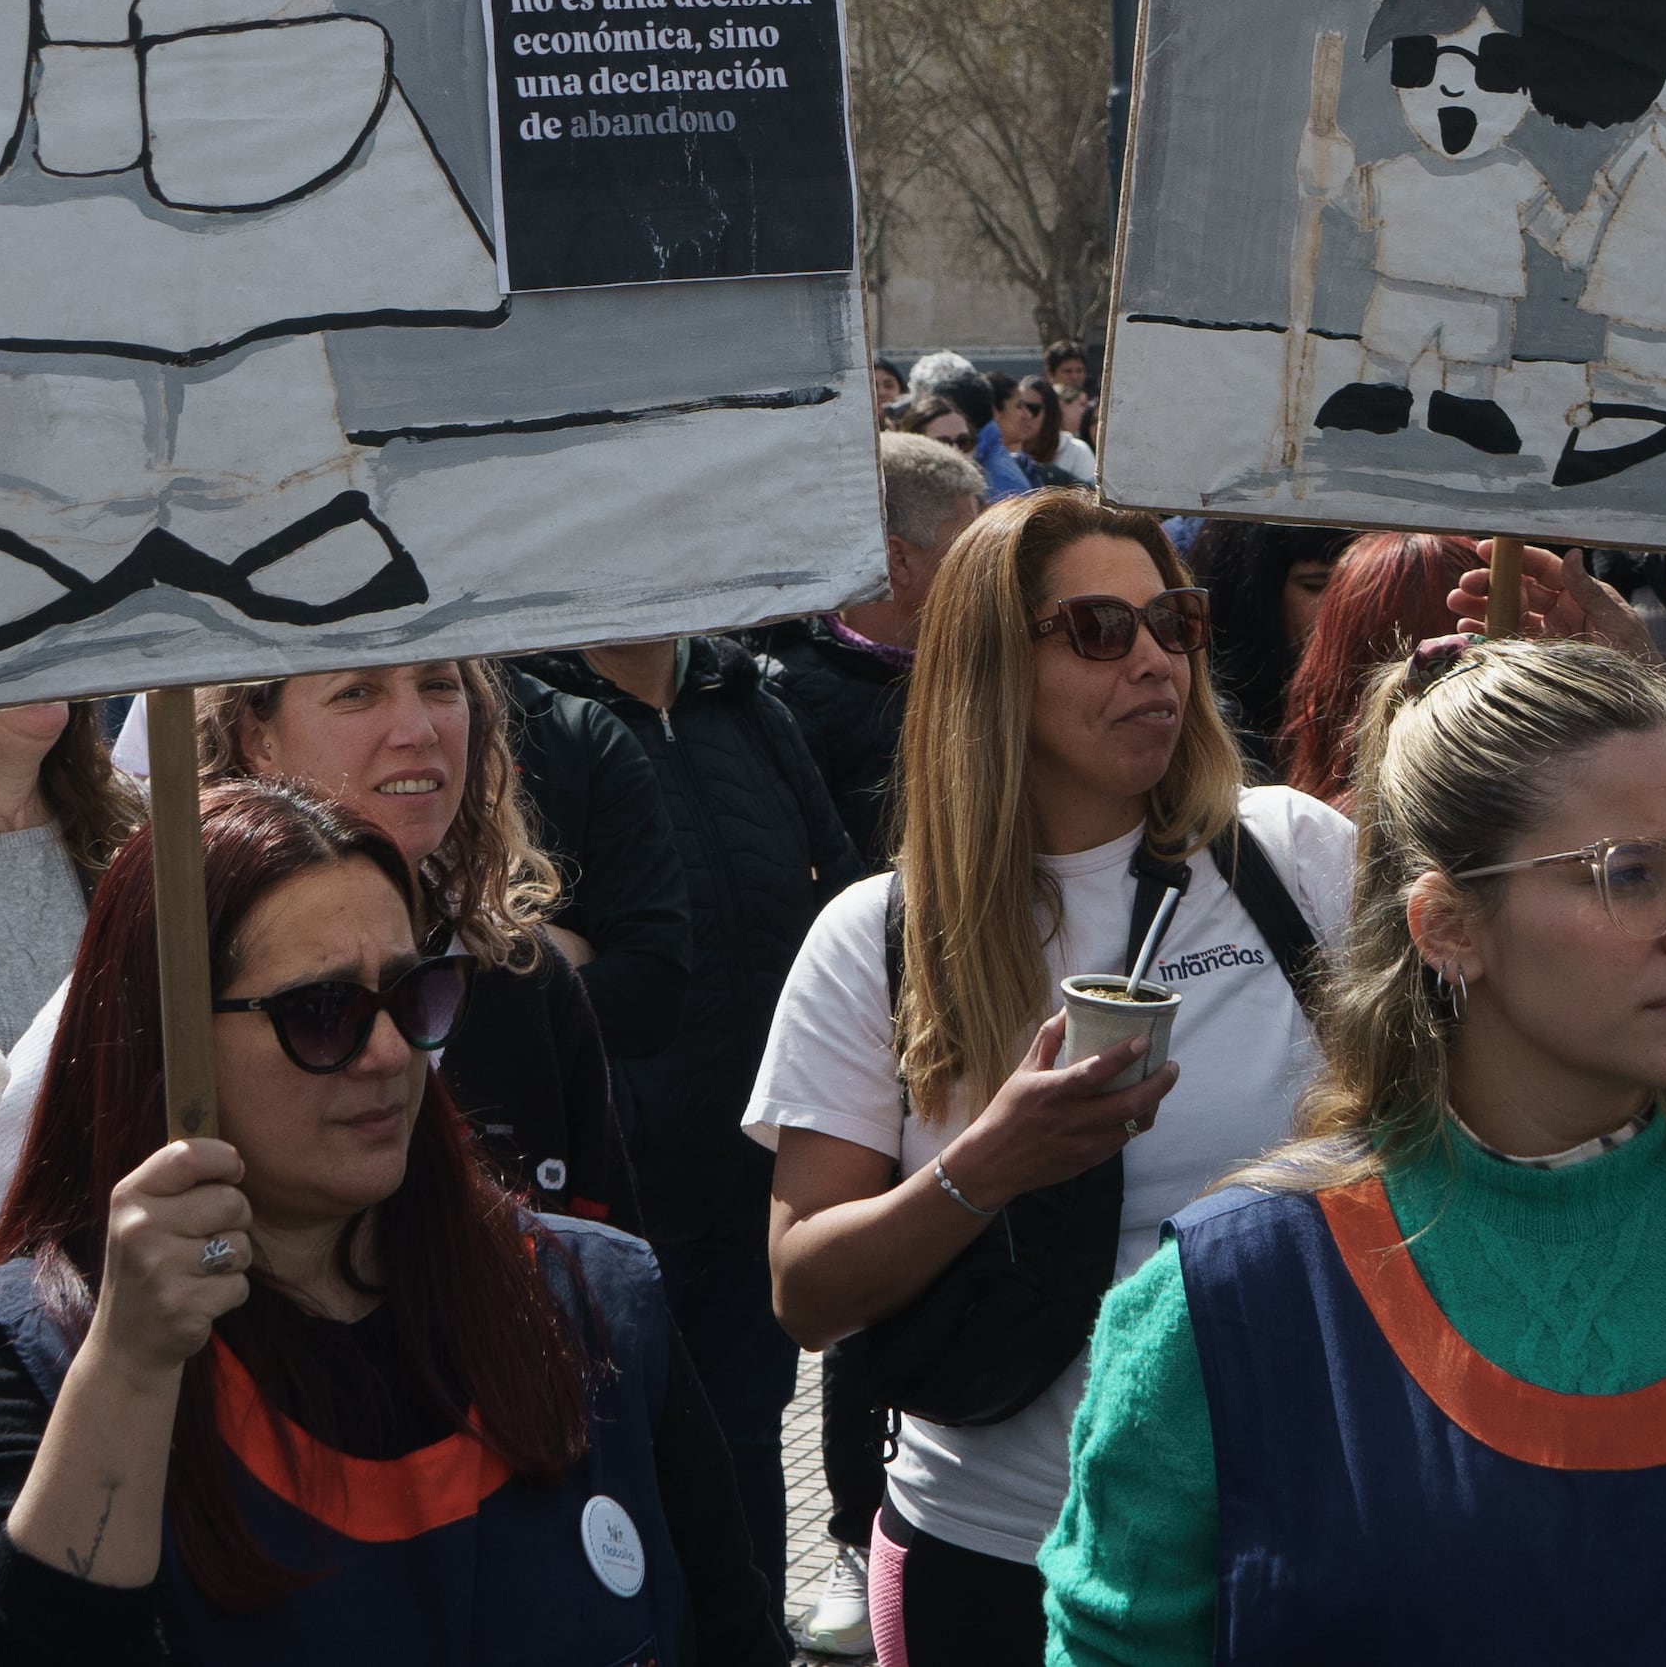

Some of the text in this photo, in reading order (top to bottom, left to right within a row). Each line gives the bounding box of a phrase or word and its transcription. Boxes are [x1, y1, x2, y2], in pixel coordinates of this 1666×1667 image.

[513, 18, 781, 57] económica, sino
[514, 57, 789, 99] una declaración
[518, 102, 737, 142] de abandono
[1157, 943, 1265, 983] infancias
